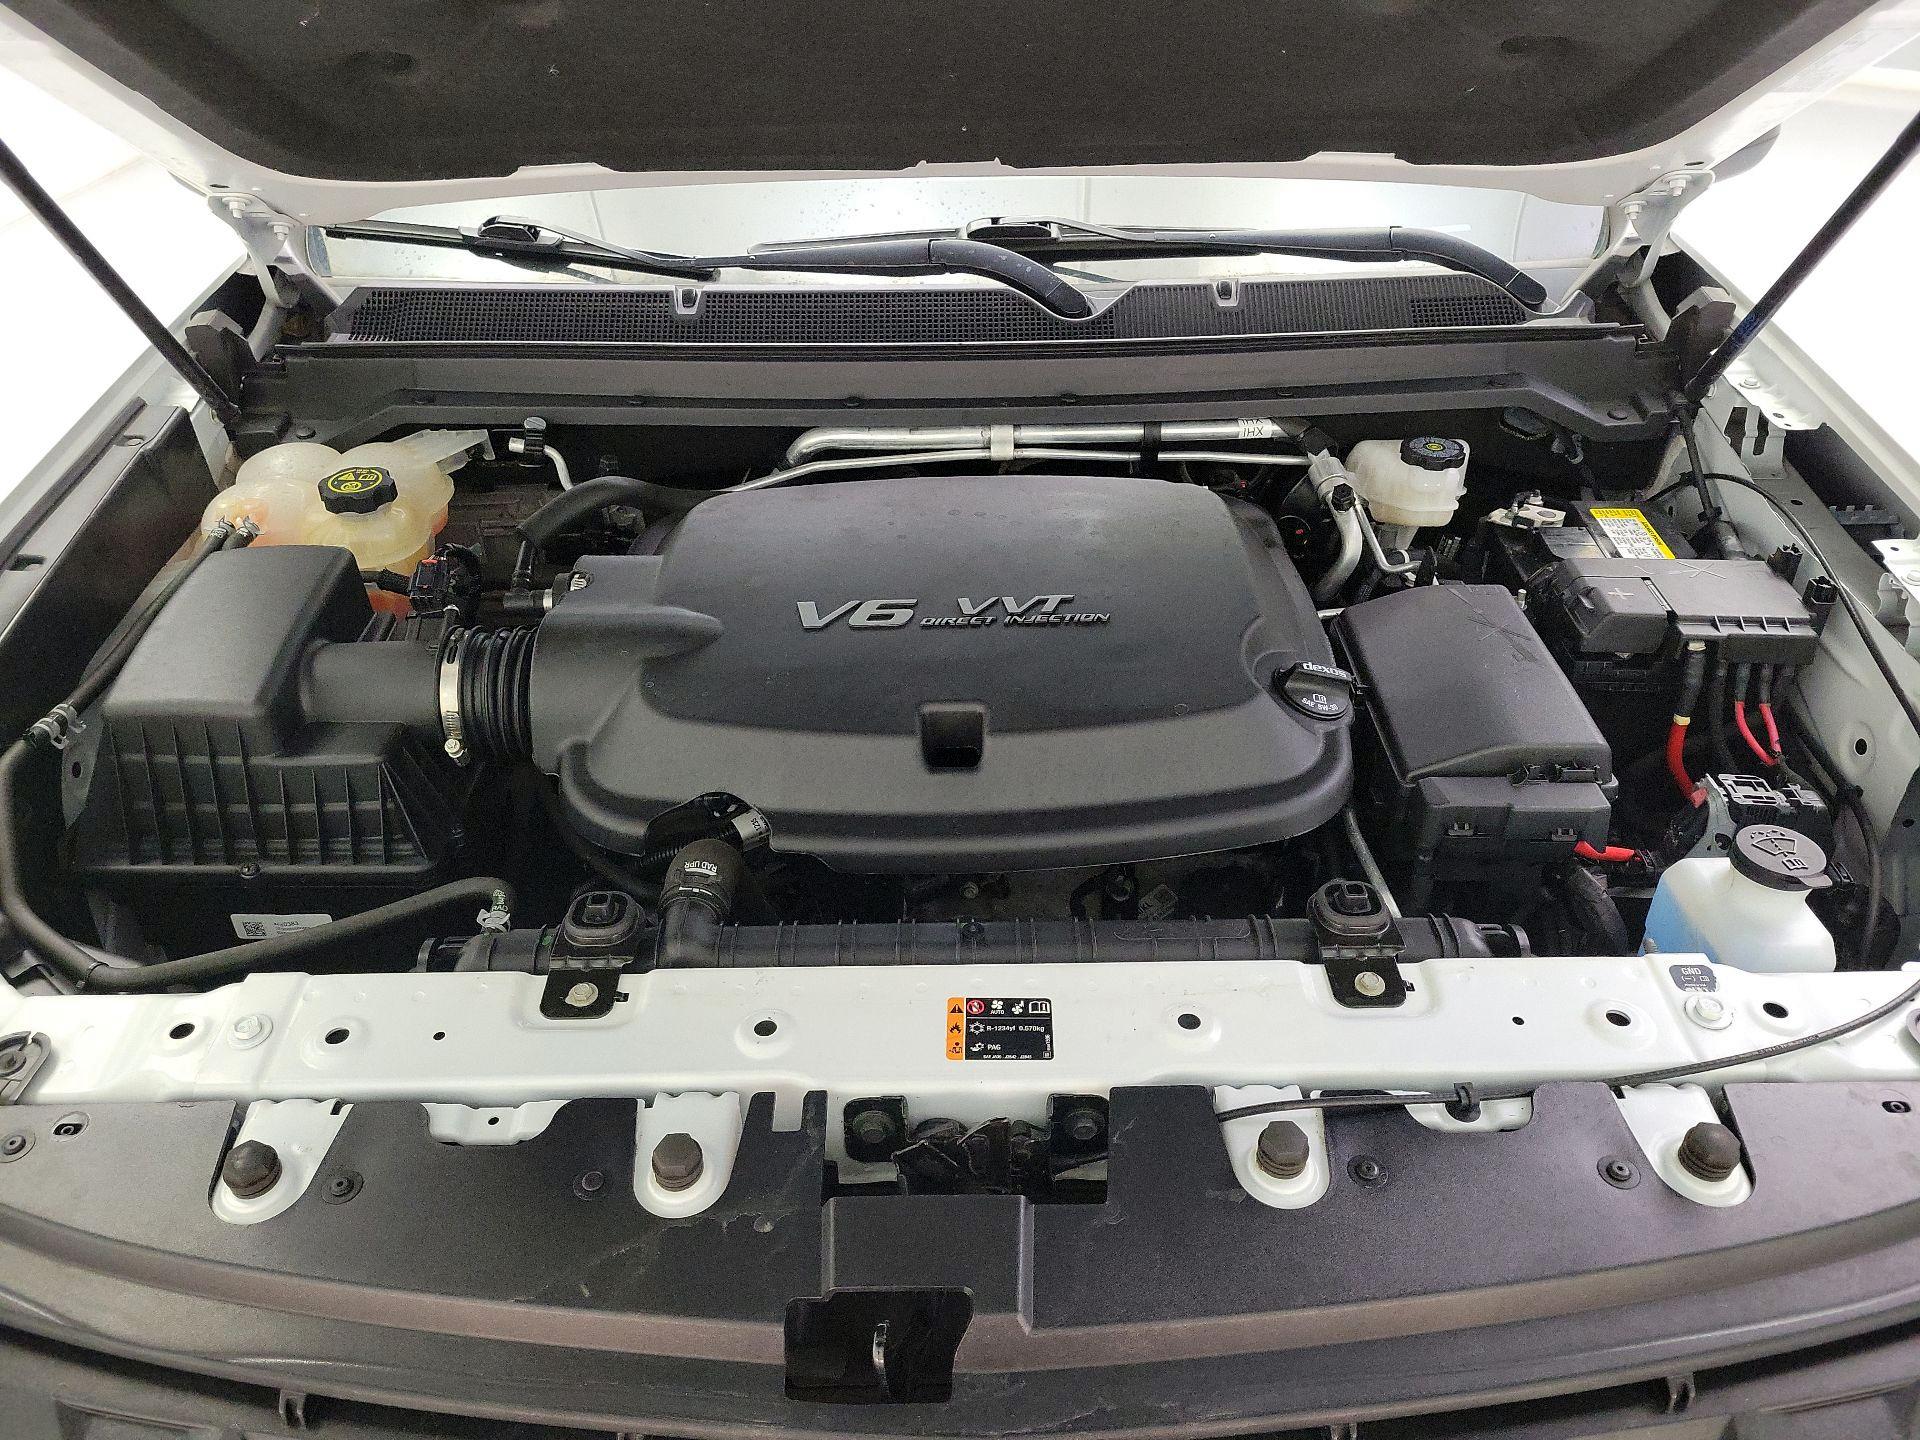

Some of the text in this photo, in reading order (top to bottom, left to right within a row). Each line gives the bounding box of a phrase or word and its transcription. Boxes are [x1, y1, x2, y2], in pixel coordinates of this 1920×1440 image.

[957, 594, 1075, 615] VVT
[796, 599, 918, 629] V6
[919, 612, 1111, 629] DIRECT INJECTION
[1302, 661, 1347, 678] dexos
[1302, 697, 1315, 708] SAE
[684, 860, 718, 873] RAD UPR
[1681, 967, 1702, 975] GND
